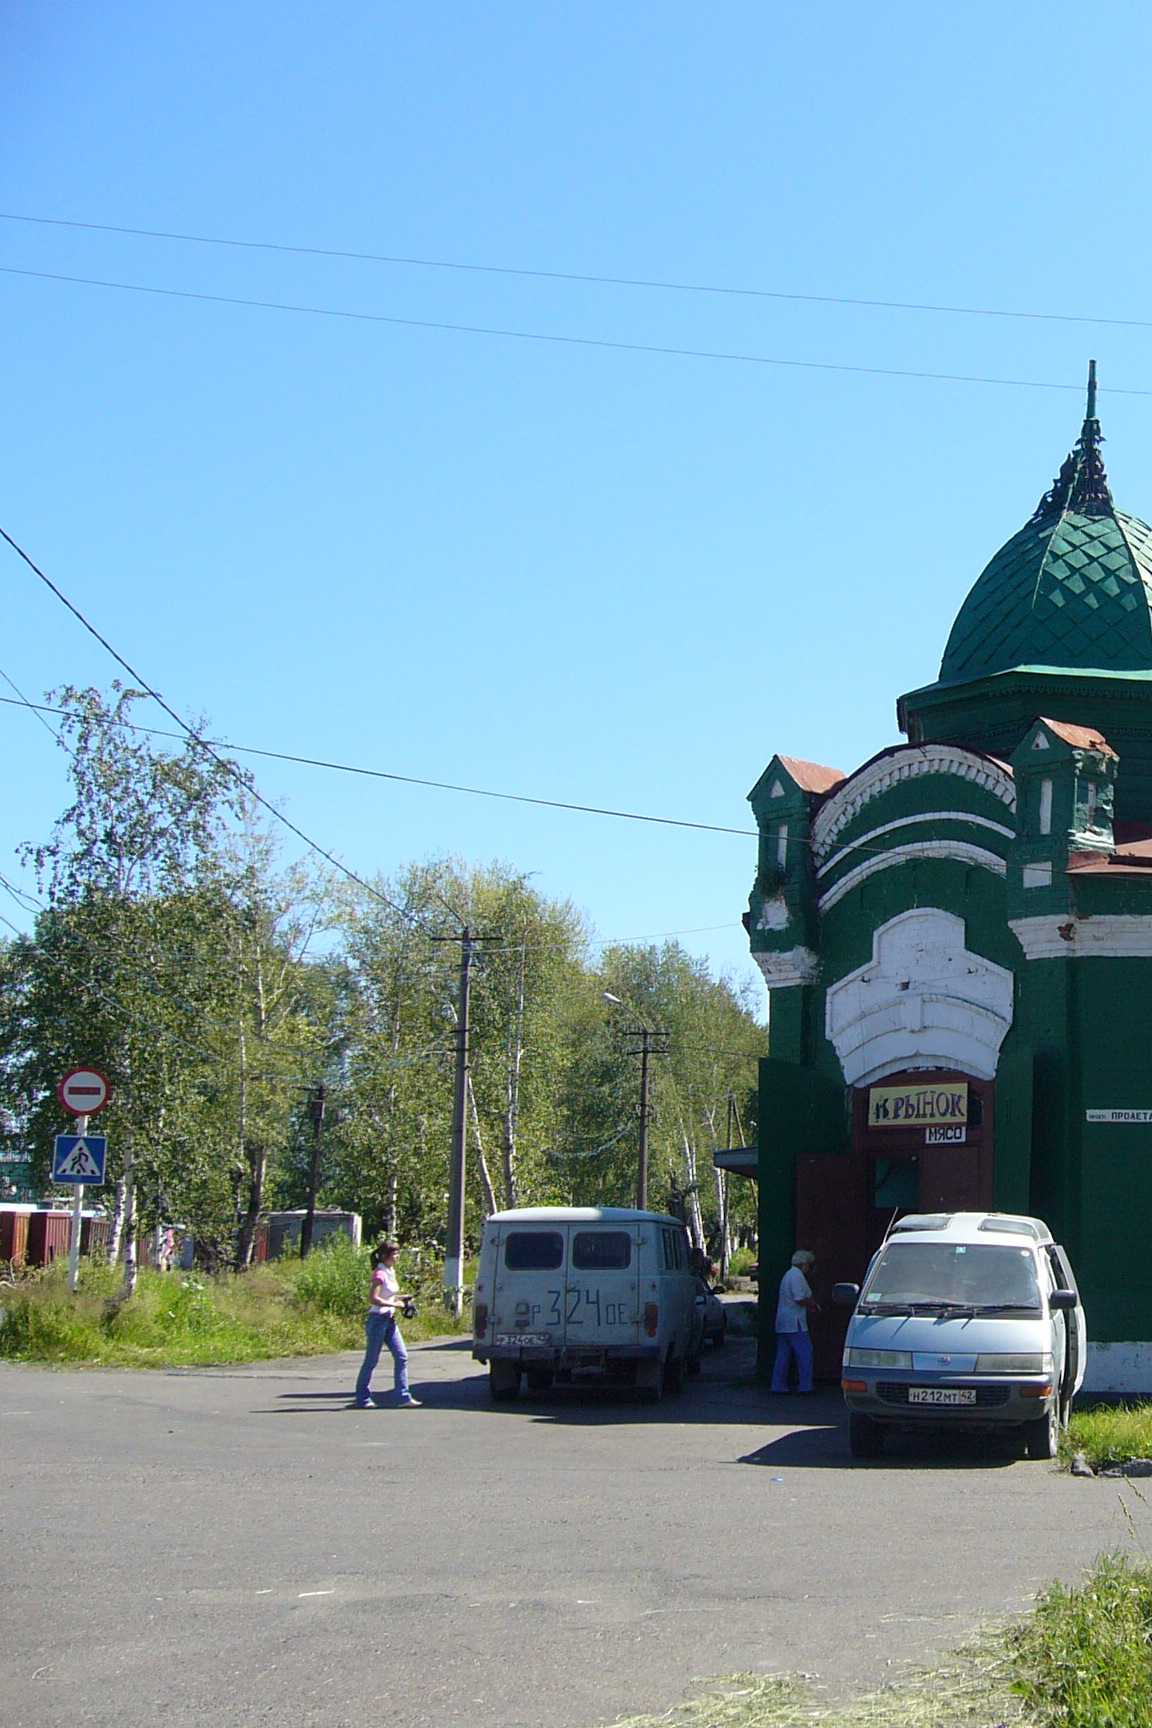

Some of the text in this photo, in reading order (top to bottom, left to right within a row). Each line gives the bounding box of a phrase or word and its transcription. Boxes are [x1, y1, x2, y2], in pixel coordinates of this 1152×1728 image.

[928, 1127, 963, 1141] МЯСО
[913, 1390, 972, 1402] Н212МТ 42
